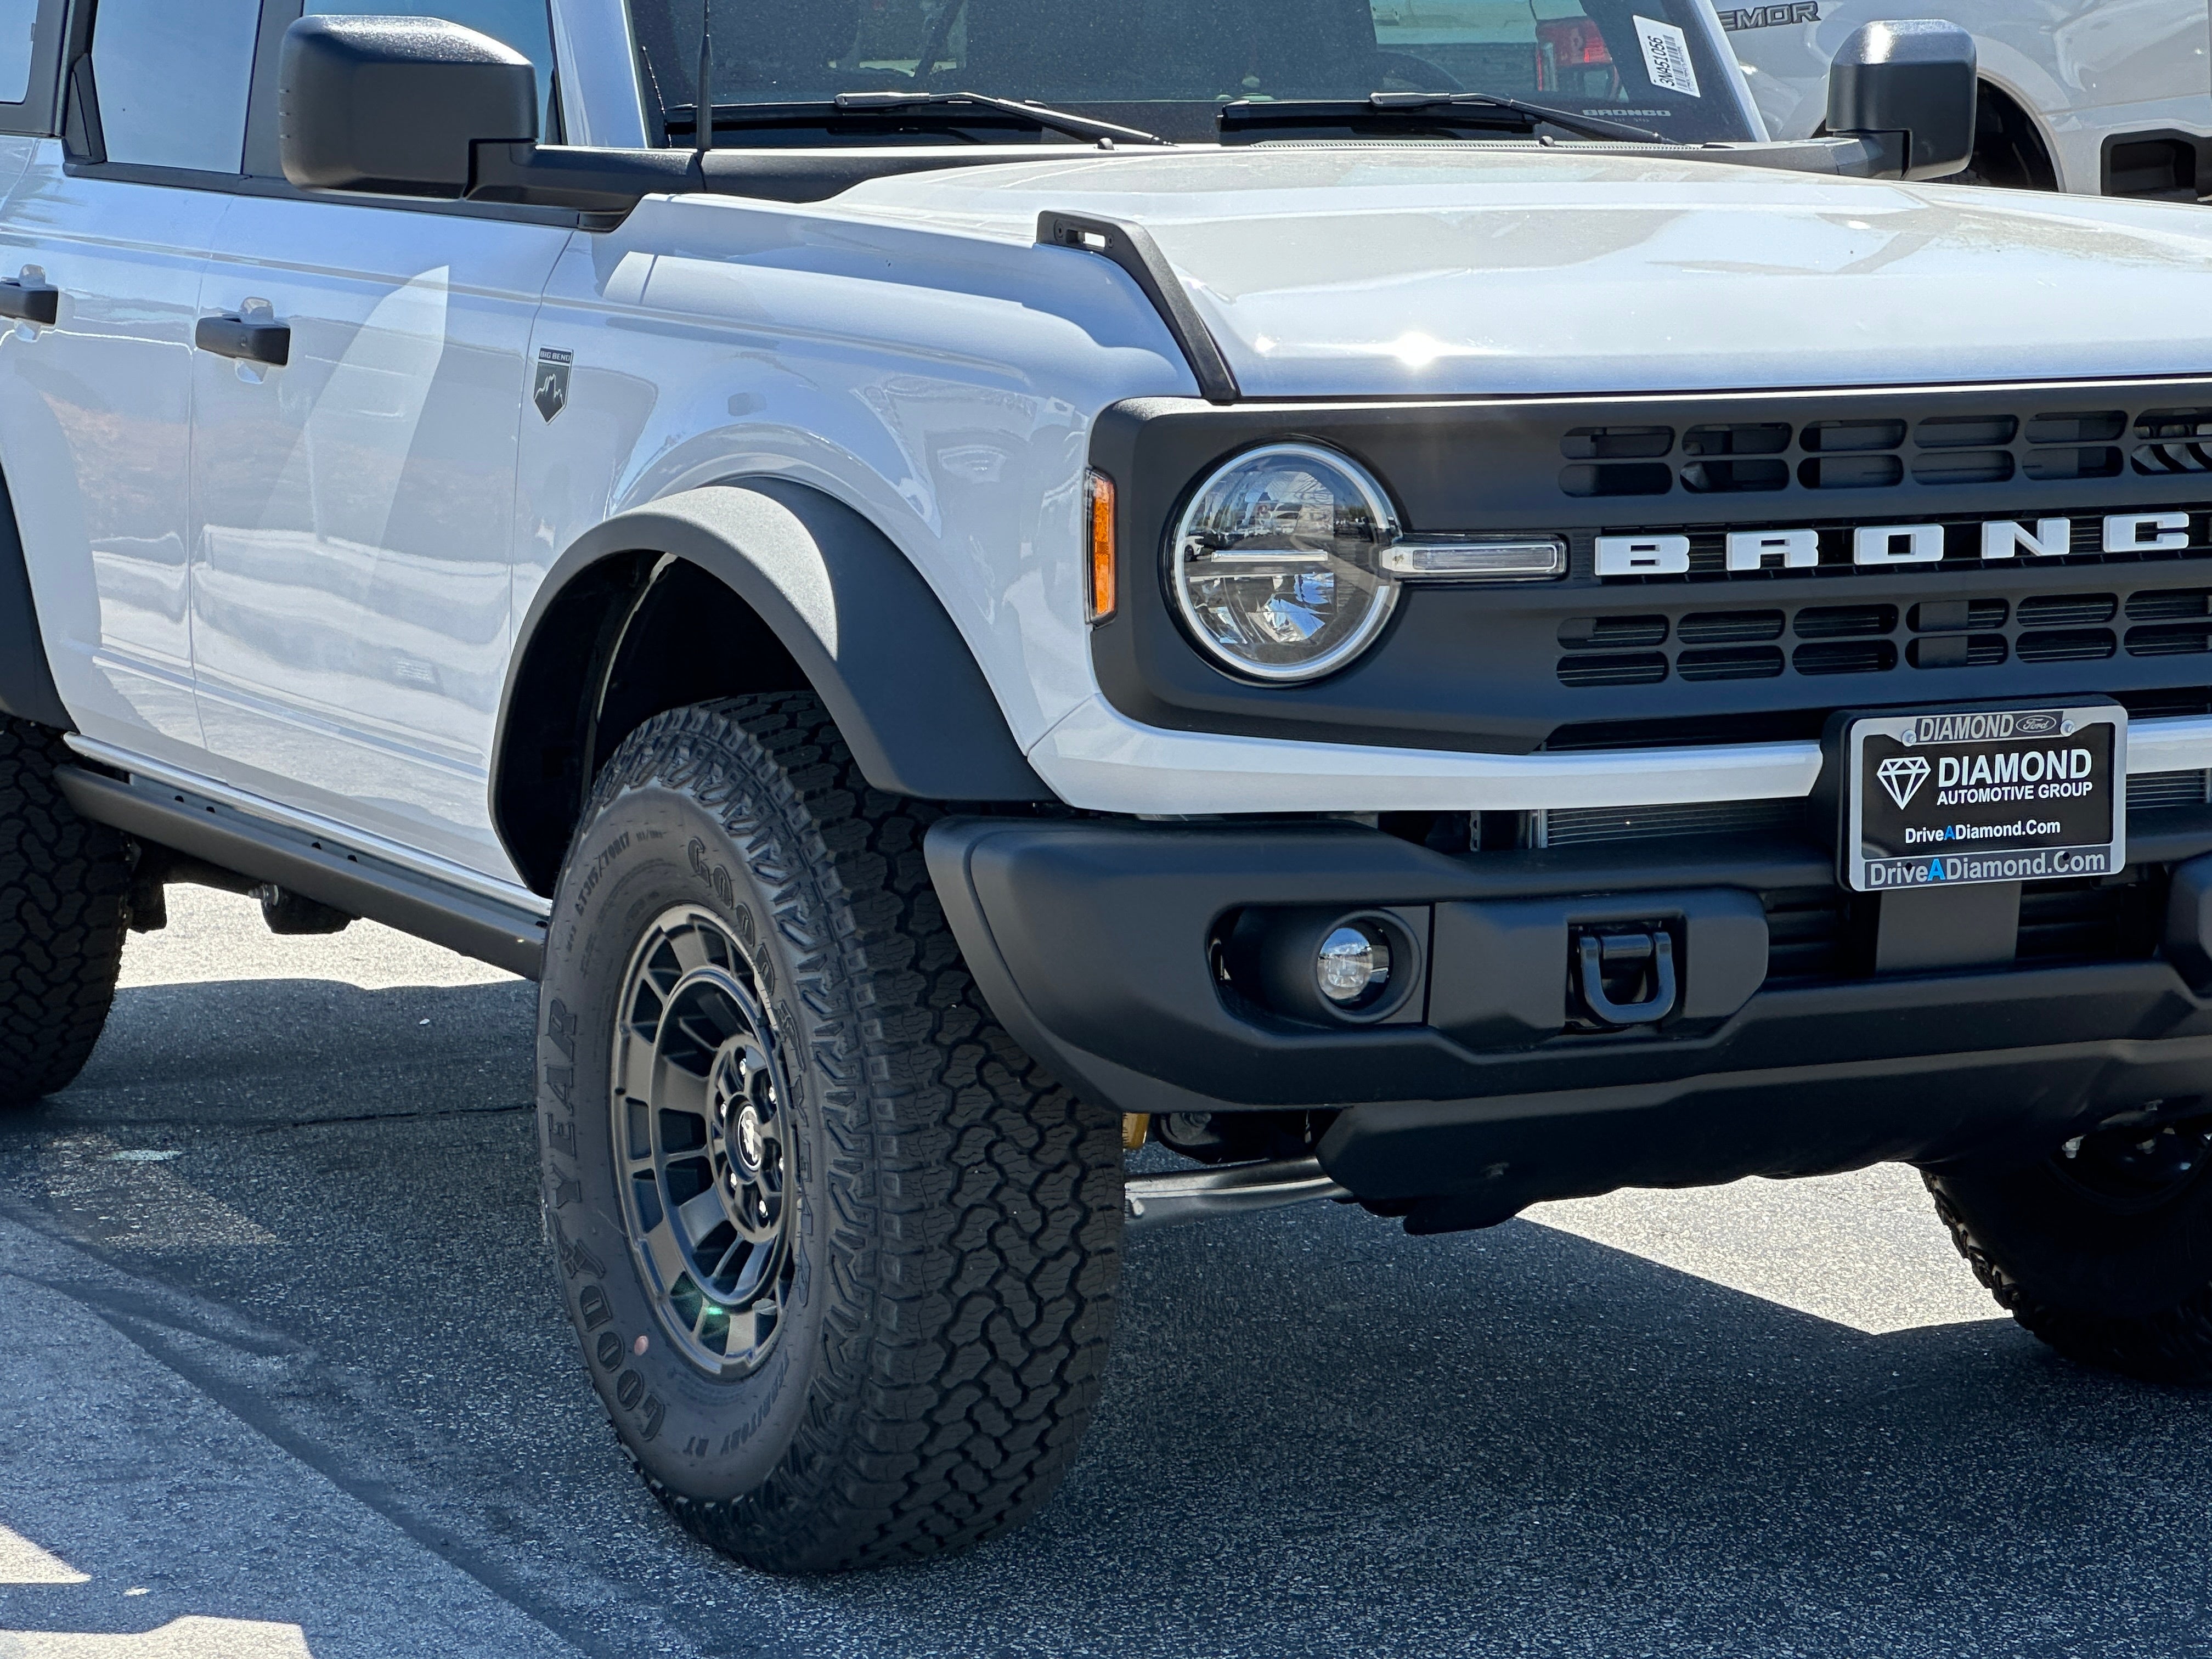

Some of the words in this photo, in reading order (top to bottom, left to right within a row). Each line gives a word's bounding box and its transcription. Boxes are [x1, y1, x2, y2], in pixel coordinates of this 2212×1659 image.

[1647, 36, 1675, 86] 3NA51056
[552, 352, 571, 361] BEND
[1920, 714, 2014, 742] DIAMOND
[2023, 718, 2049, 730] Ford
[1938, 749, 2092, 788] DIAMOND
[1937, 785, 2034, 806] AUTOMOTIVE
[2038, 781, 2094, 799] GROUP
[1905, 819, 2061, 844] DriveADiamond.Com
[1870, 851, 2106, 886] DriveADiamond.Com
